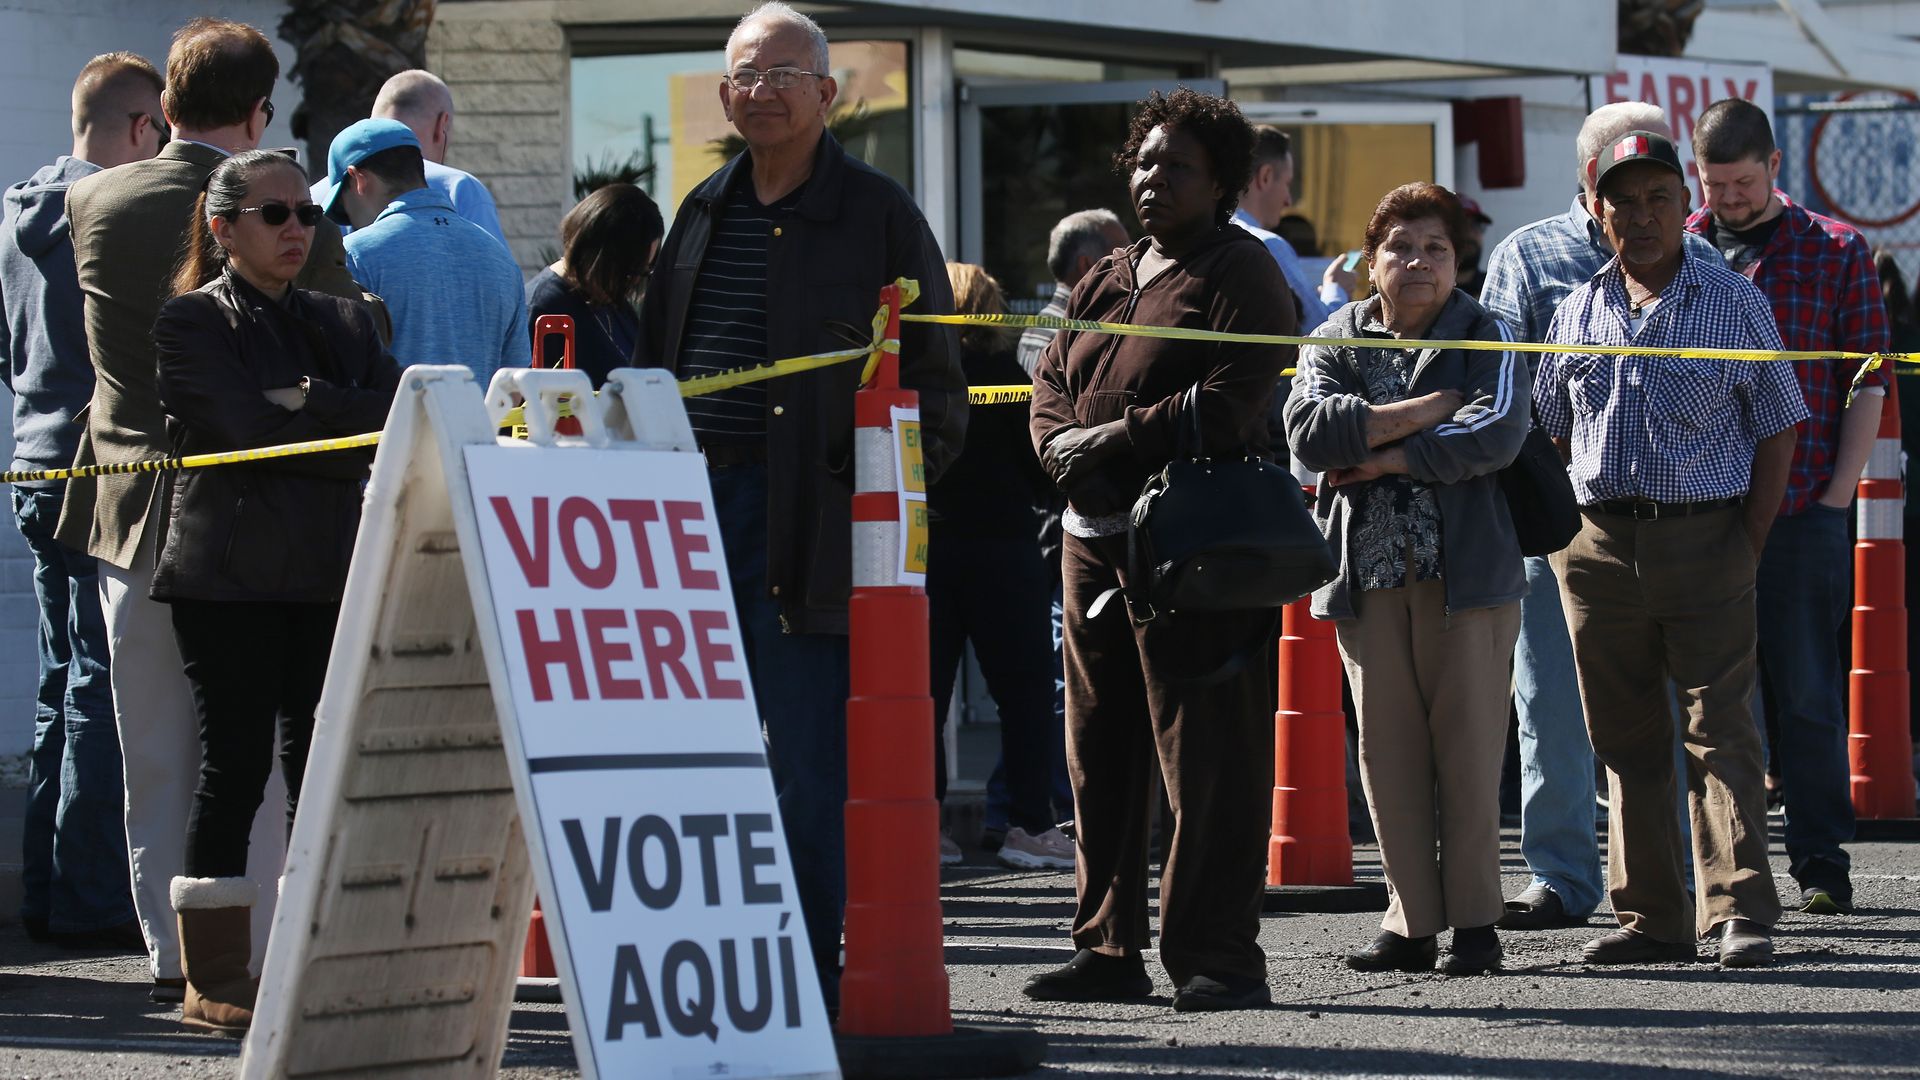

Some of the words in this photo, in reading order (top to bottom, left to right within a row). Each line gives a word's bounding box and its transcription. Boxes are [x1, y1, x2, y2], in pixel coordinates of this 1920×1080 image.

[488, 496, 720, 590] VOTE
[515, 608, 745, 702] HERE
[560, 813, 784, 913] VOTE
[605, 911, 802, 1043] AQUÍ
